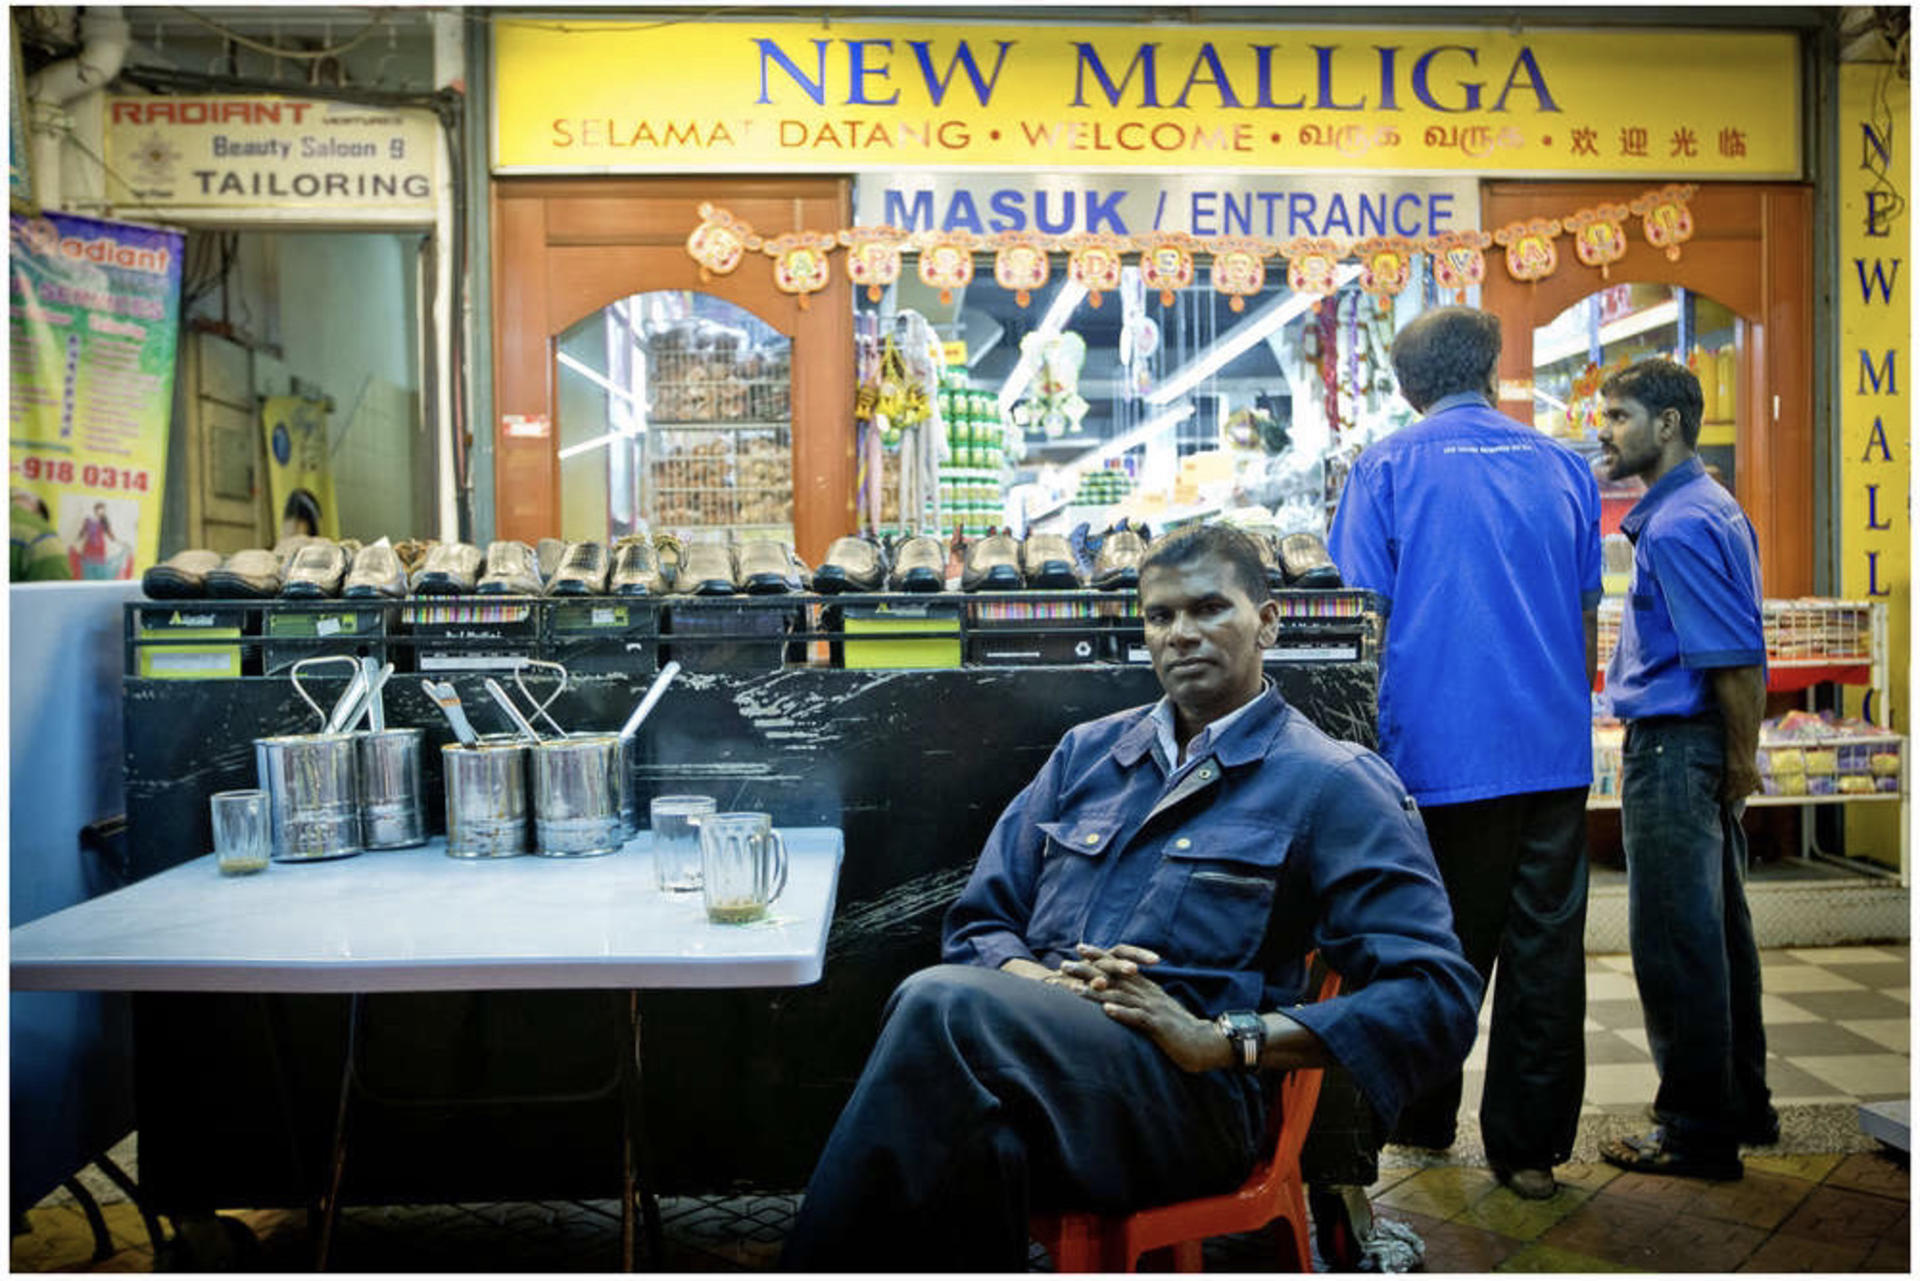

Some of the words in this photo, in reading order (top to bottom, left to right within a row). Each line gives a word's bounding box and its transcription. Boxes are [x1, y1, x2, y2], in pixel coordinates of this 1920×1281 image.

[752, 38, 1018, 107] NEW
[1069, 40, 1563, 114] MALLIGA
[112, 101, 312, 125] RADIANT
[212, 135, 292, 159] Beauty
[300, 135, 376, 159] Saloon
[779, 119, 971, 149] DATANG
[1020, 121, 1255, 151] WELCOME
[1571, 126, 1748, 158] 欢迎光临
[192, 170, 431, 198] TAILORING
[884, 189, 1128, 235] MASUK
[1191, 192, 1455, 238] ENTRANCE
[1854, 121, 1901, 305] NEW
[83, 464, 149, 492] 0314
